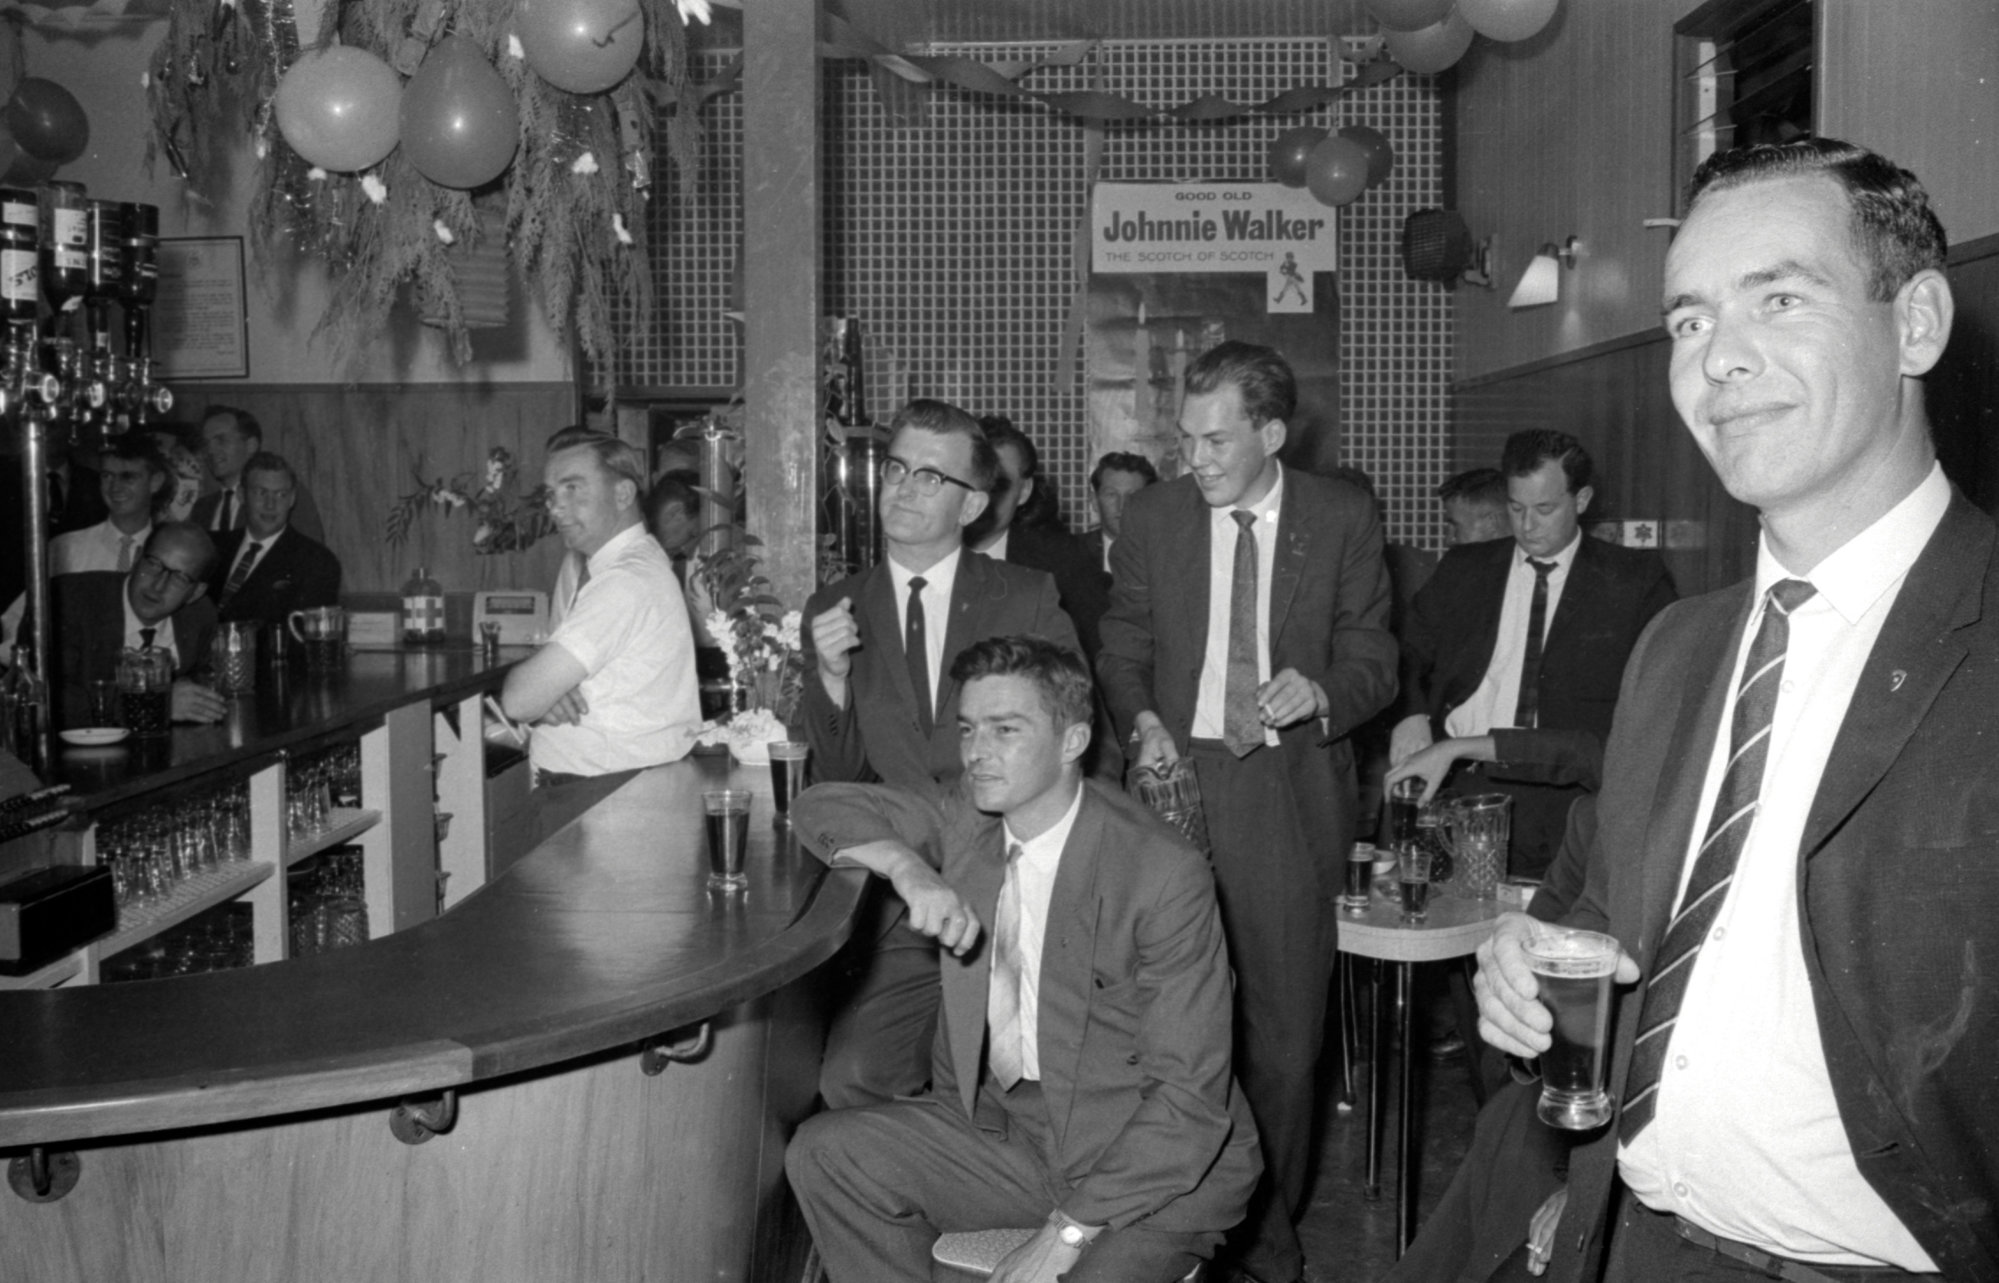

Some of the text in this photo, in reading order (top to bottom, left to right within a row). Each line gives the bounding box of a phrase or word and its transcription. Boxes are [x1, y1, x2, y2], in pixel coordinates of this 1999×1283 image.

[1174, 191, 1253, 201] GOOD OLD
[1103, 209, 1325, 242] Johnnie Walker
[1106, 251, 1275, 262] THE SCOTCH OF SCOTCH
